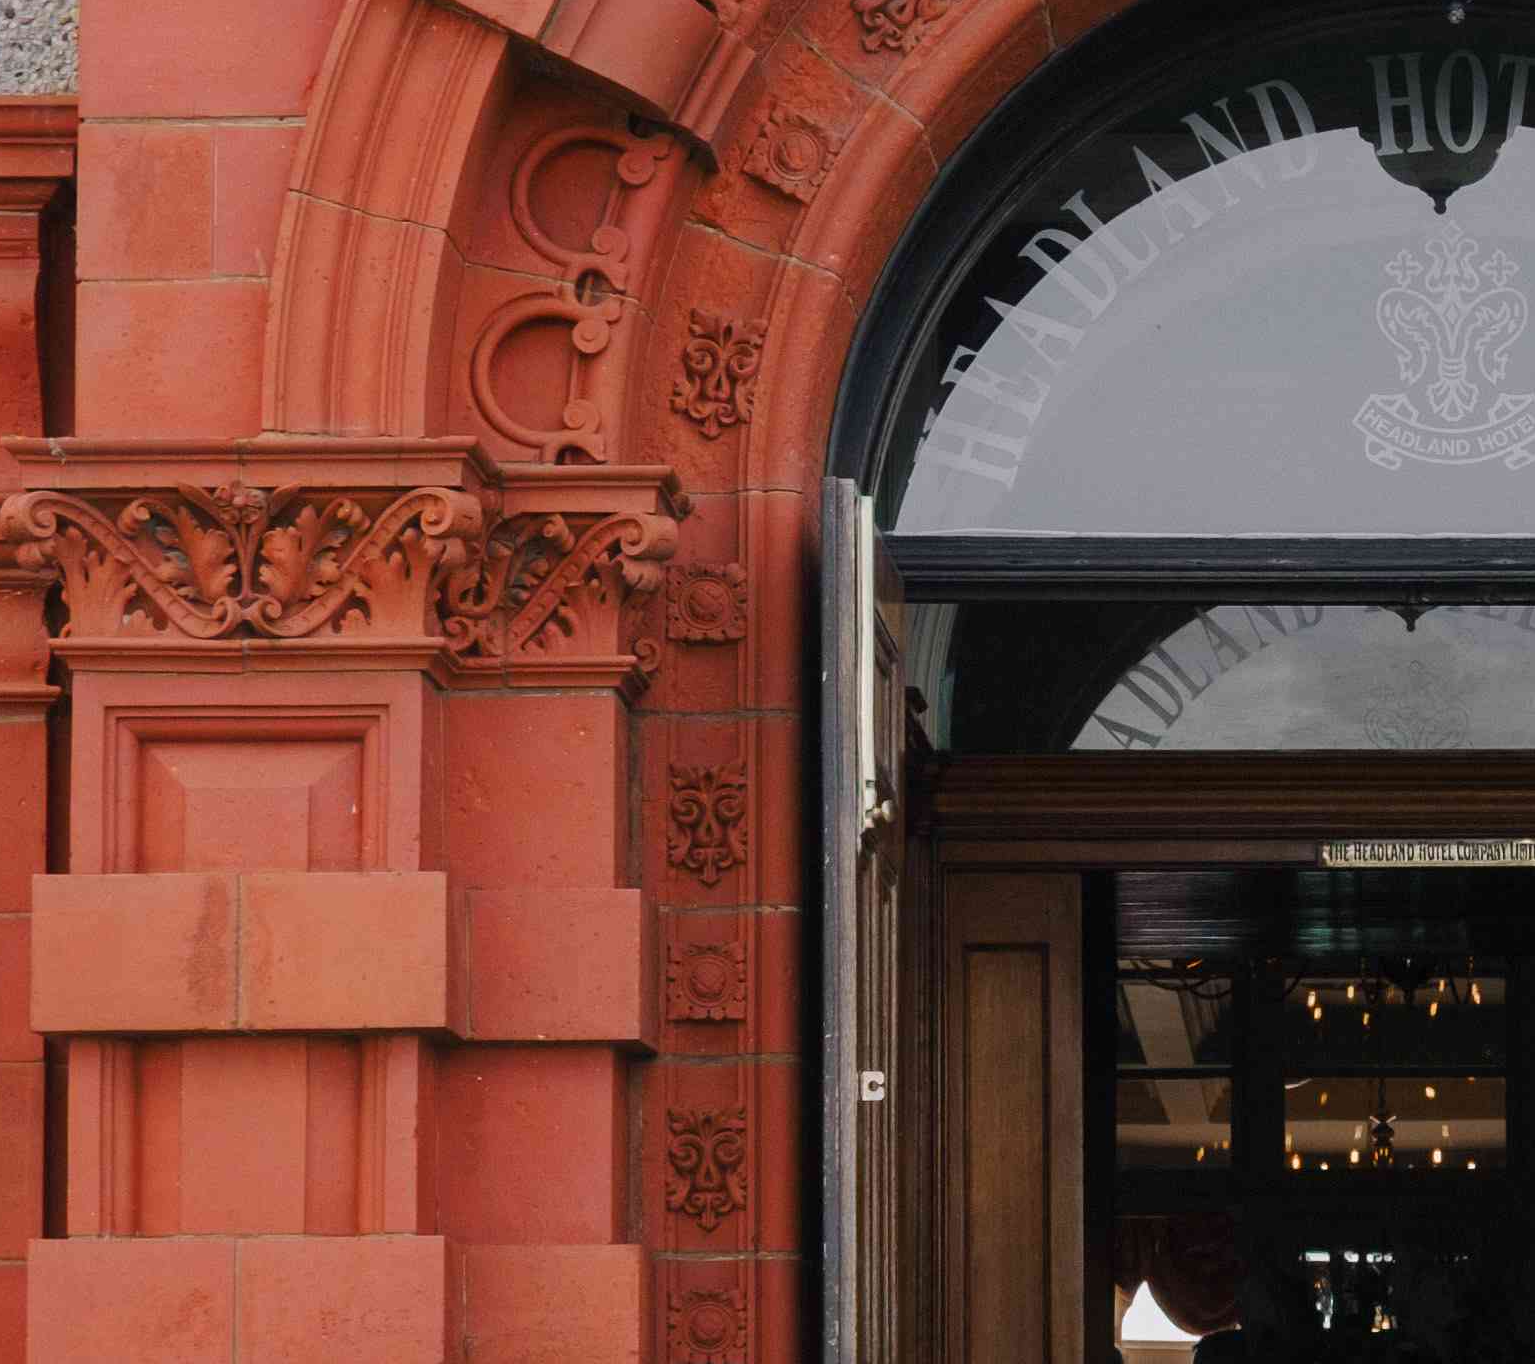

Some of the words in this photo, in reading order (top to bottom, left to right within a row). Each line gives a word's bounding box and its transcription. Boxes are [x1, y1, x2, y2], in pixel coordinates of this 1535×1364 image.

[909, 78, 1318, 491] HEADLAND
[1364, 408, 1471, 456] HEADLAND
[1328, 842, 1349, 861] THE
[1353, 842, 1414, 861] HEADLAND
[1418, 842, 1454, 861] HOTEL
[1457, 842, 1506, 861] COMPANY
